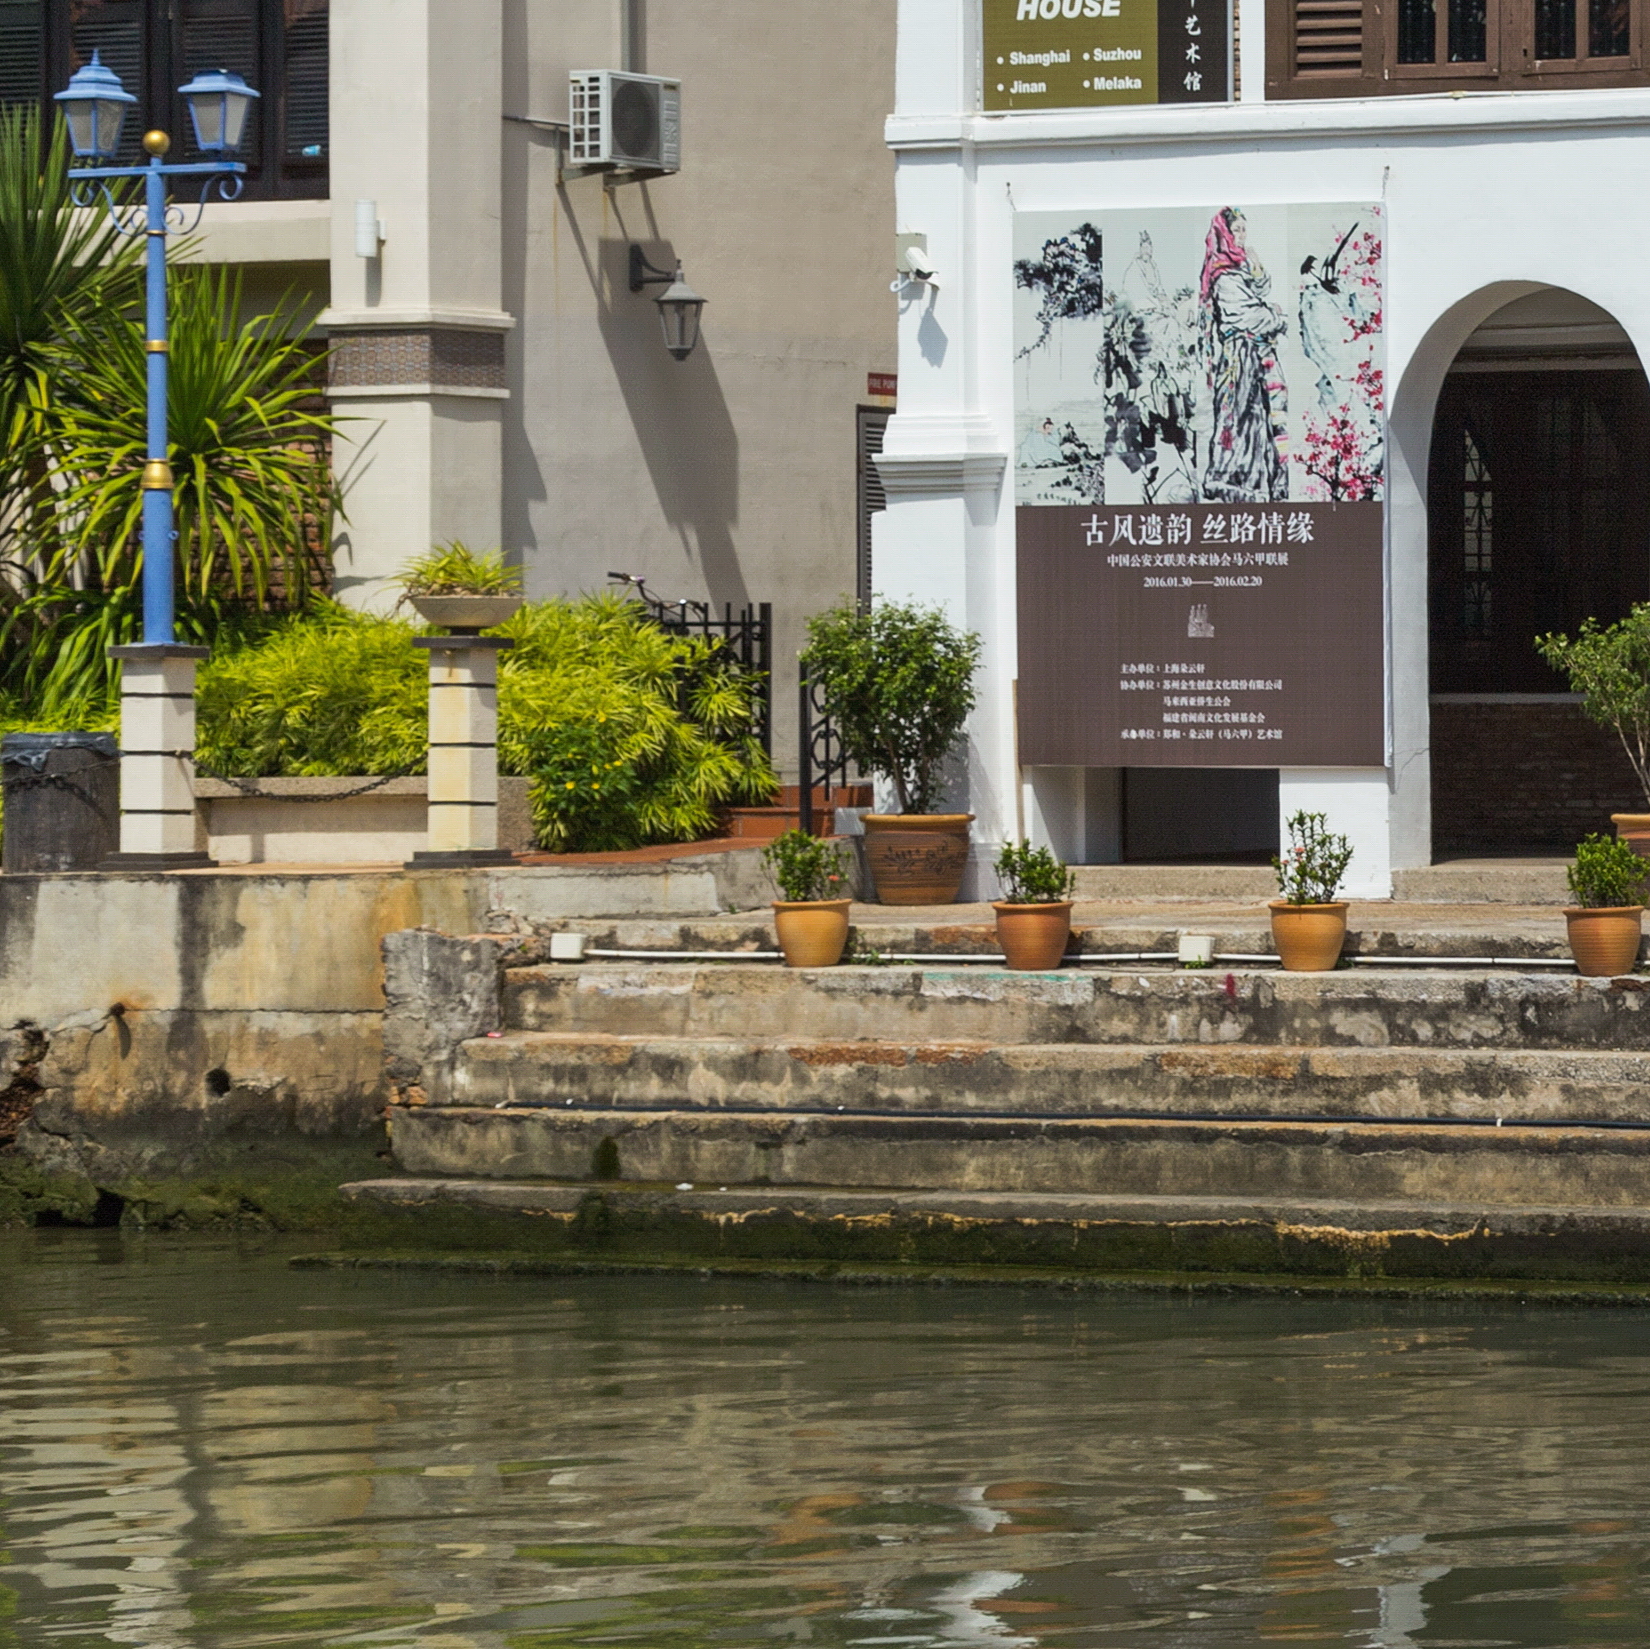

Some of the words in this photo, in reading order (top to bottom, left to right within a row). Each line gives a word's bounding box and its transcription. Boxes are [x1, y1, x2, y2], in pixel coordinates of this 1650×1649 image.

[1010, 49, 1070, 66] Shanghai
[1093, 47, 1141, 62] Suzhou
[1010, 80, 1046, 94] Jinan
[1093, 75, 1141, 90] Melaka
[1081, 513, 1192, 546] 古风遗韵
[1200, 512, 1314, 545] 丝路情缘
[1107, 552, 1289, 567] 中国公安文联美术家协会马六甲联展
